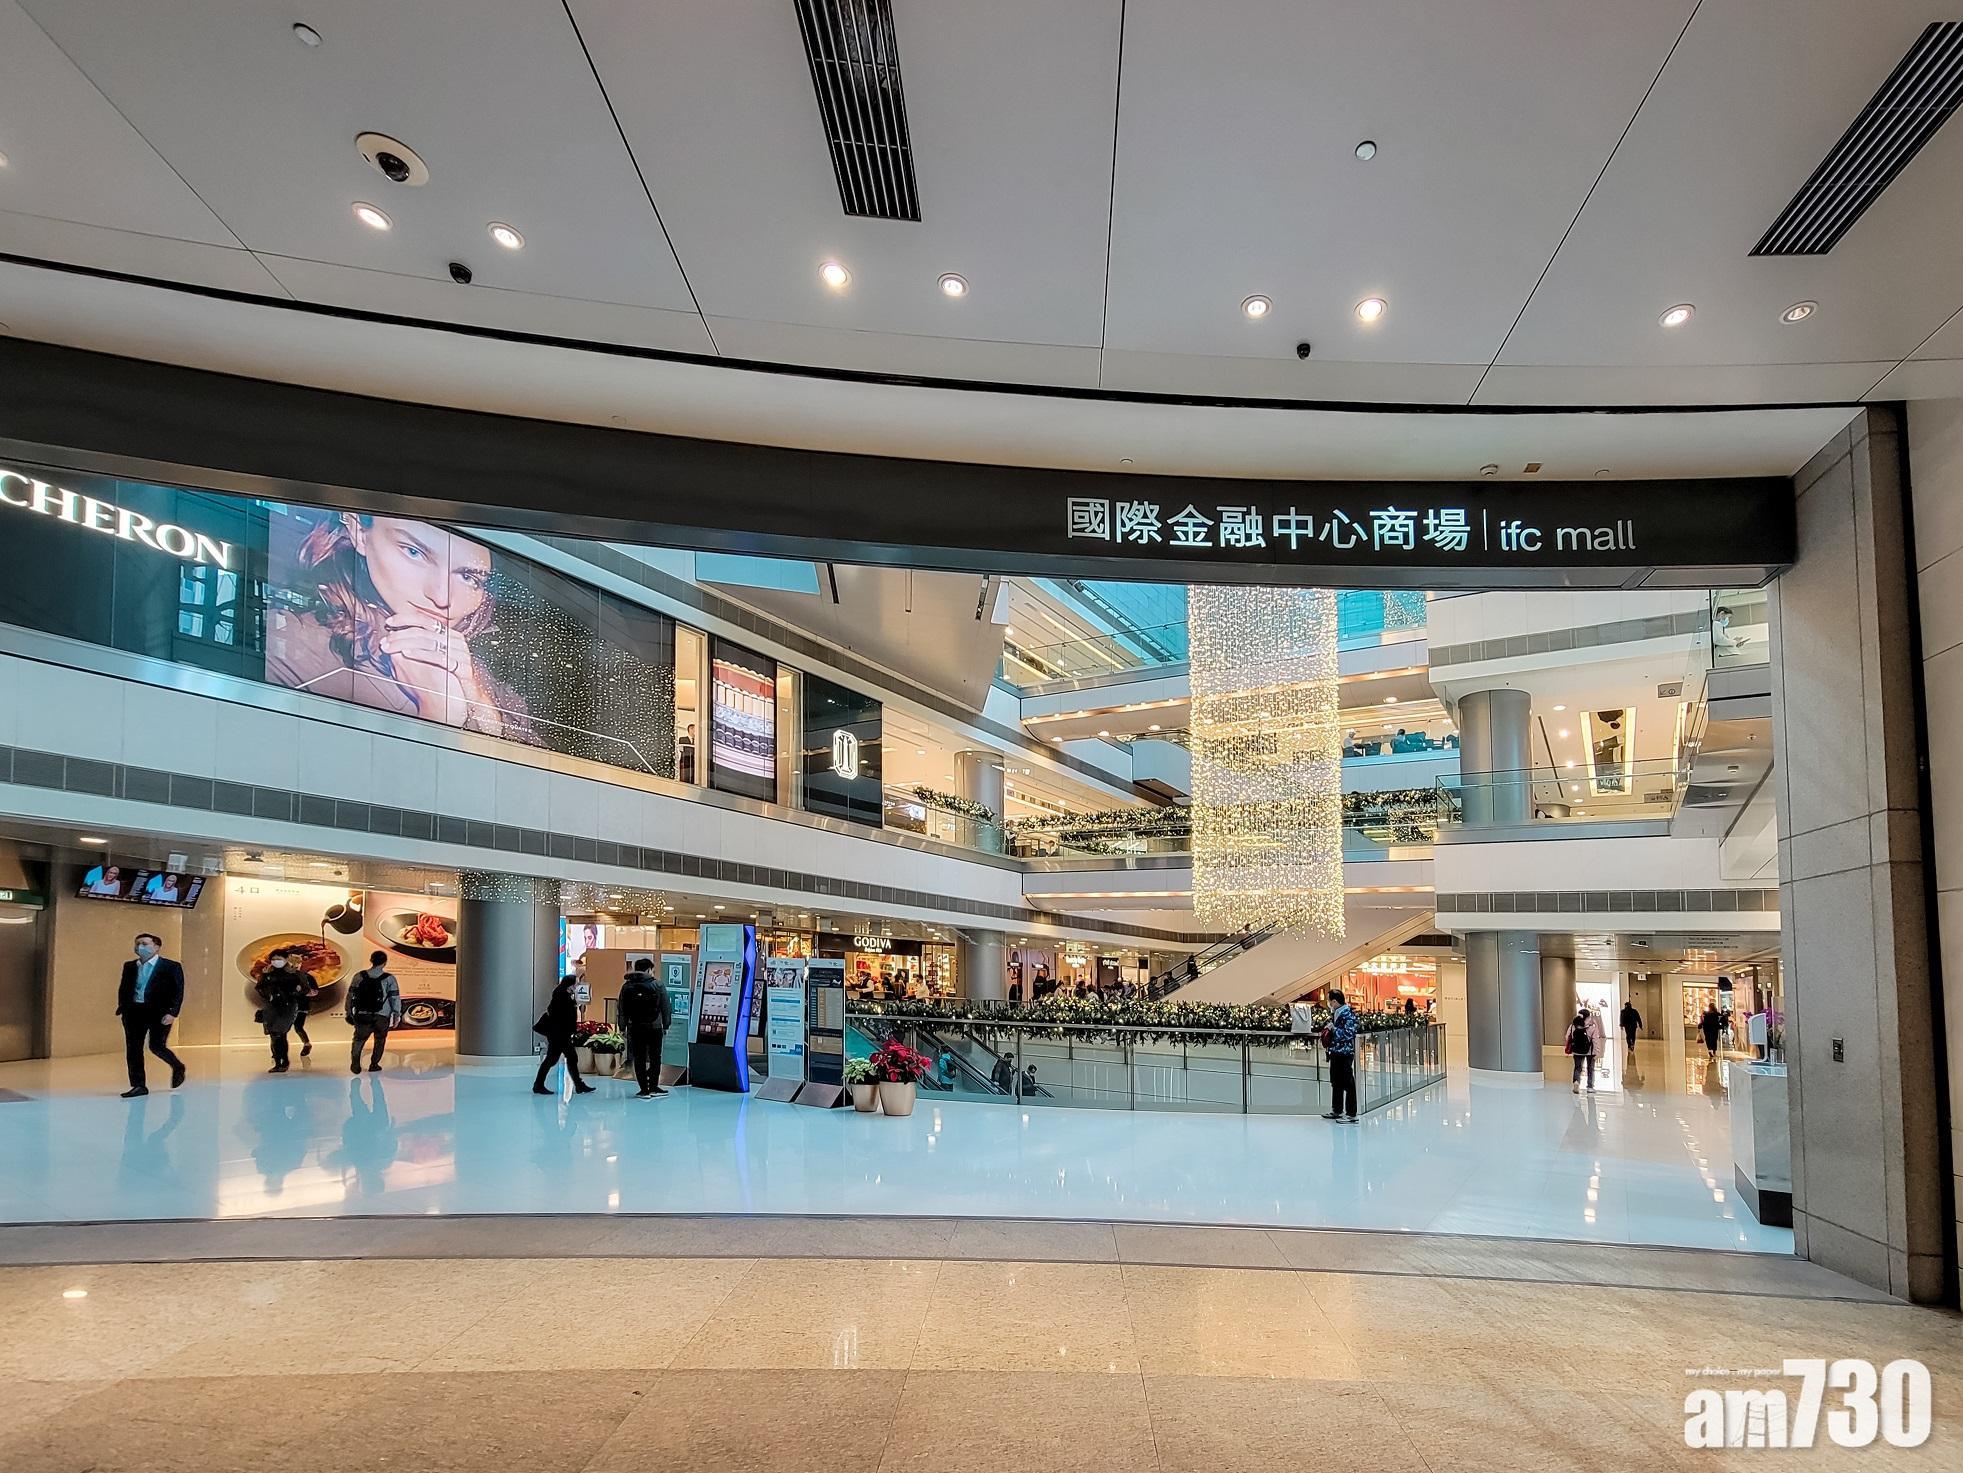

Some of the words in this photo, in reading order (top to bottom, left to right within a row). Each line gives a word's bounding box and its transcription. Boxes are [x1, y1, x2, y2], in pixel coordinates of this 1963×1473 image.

[1067, 497, 1471, 551] 國際金融中心商場
[1500, 520, 1543, 552] ifc
[1556, 519, 1637, 551] mall
[854, 936, 892, 949] GODIVA
